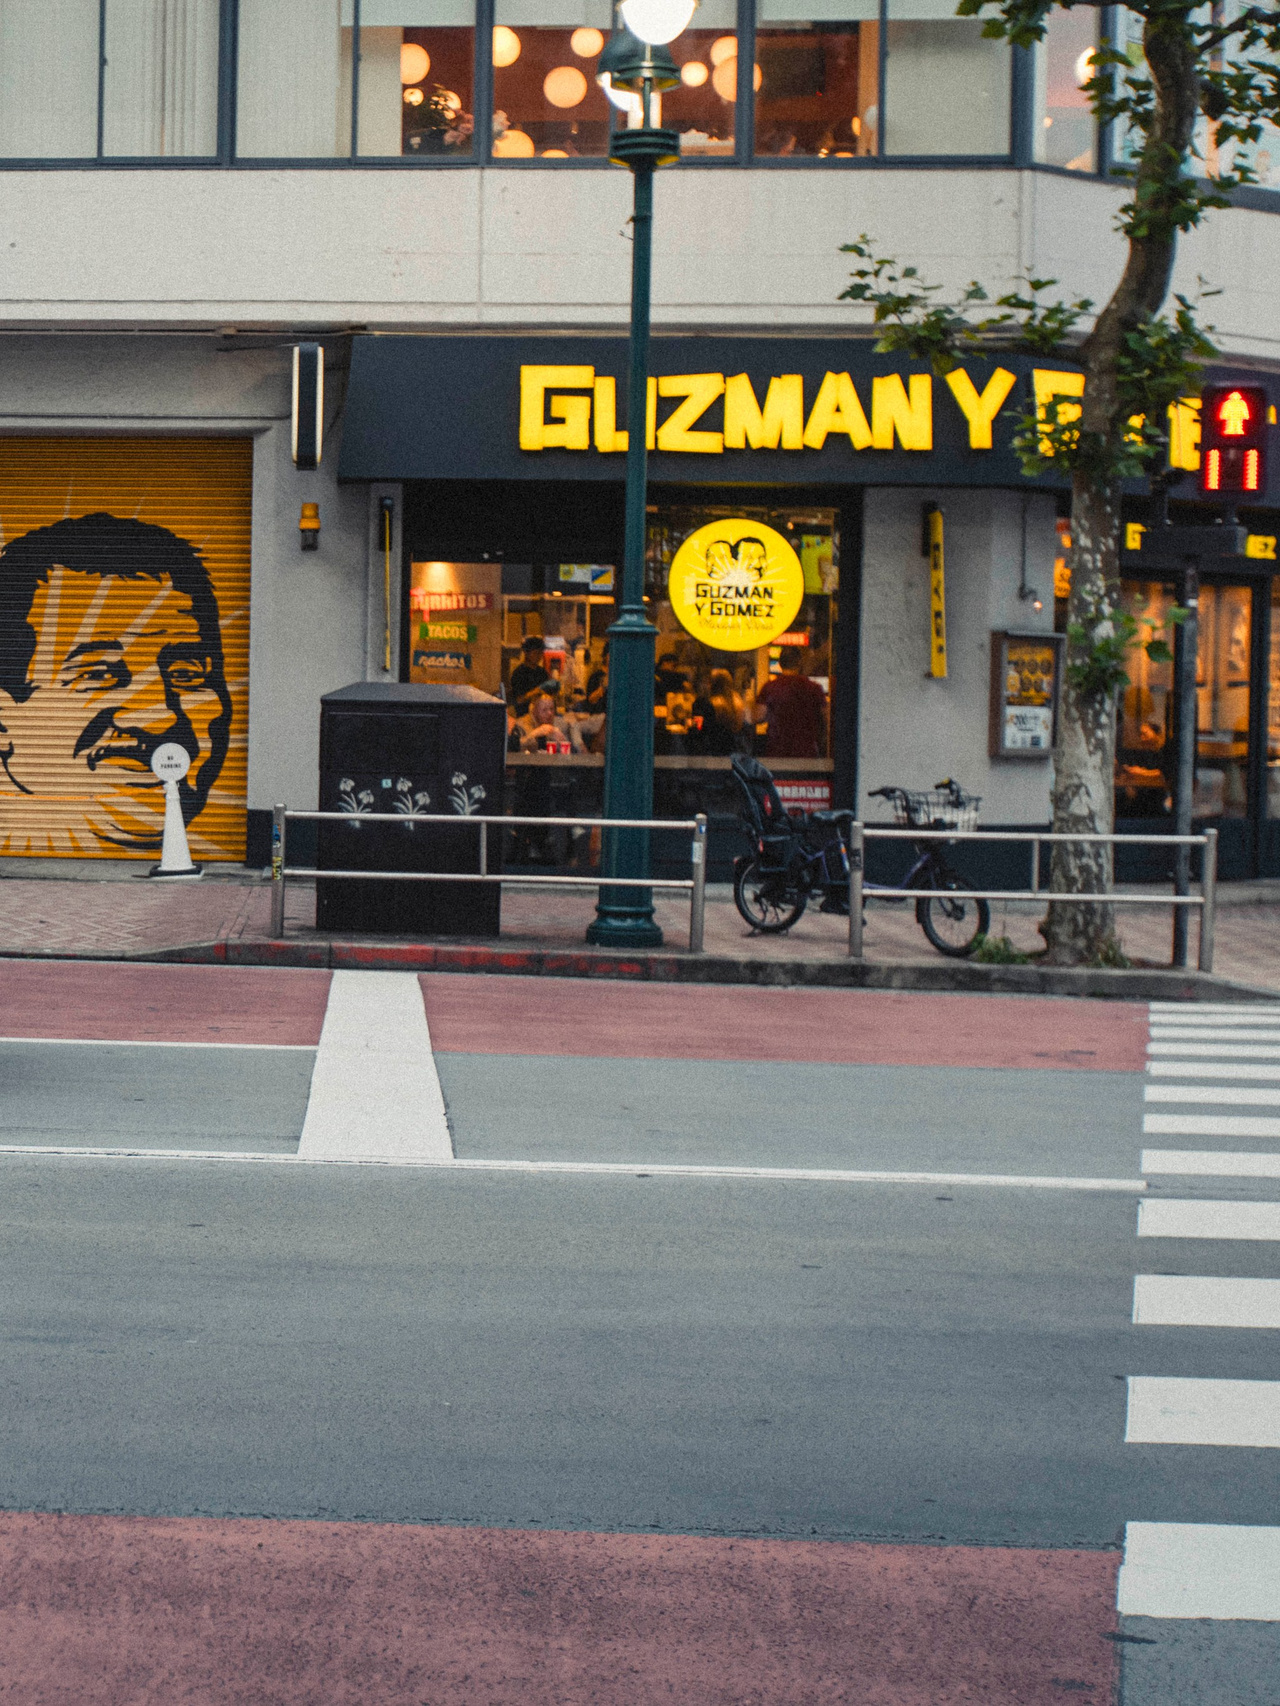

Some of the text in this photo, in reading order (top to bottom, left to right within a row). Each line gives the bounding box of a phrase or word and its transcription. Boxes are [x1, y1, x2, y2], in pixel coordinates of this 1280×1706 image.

[519, 364, 933, 454] GUZMAN
[945, 366, 1017, 450] Y
[696, 583, 773, 599] GUZMAN
[695, 601, 774, 617] Y GOMEZ
[427, 625, 468, 641] TACOS
[419, 653, 465, 667] nachos
